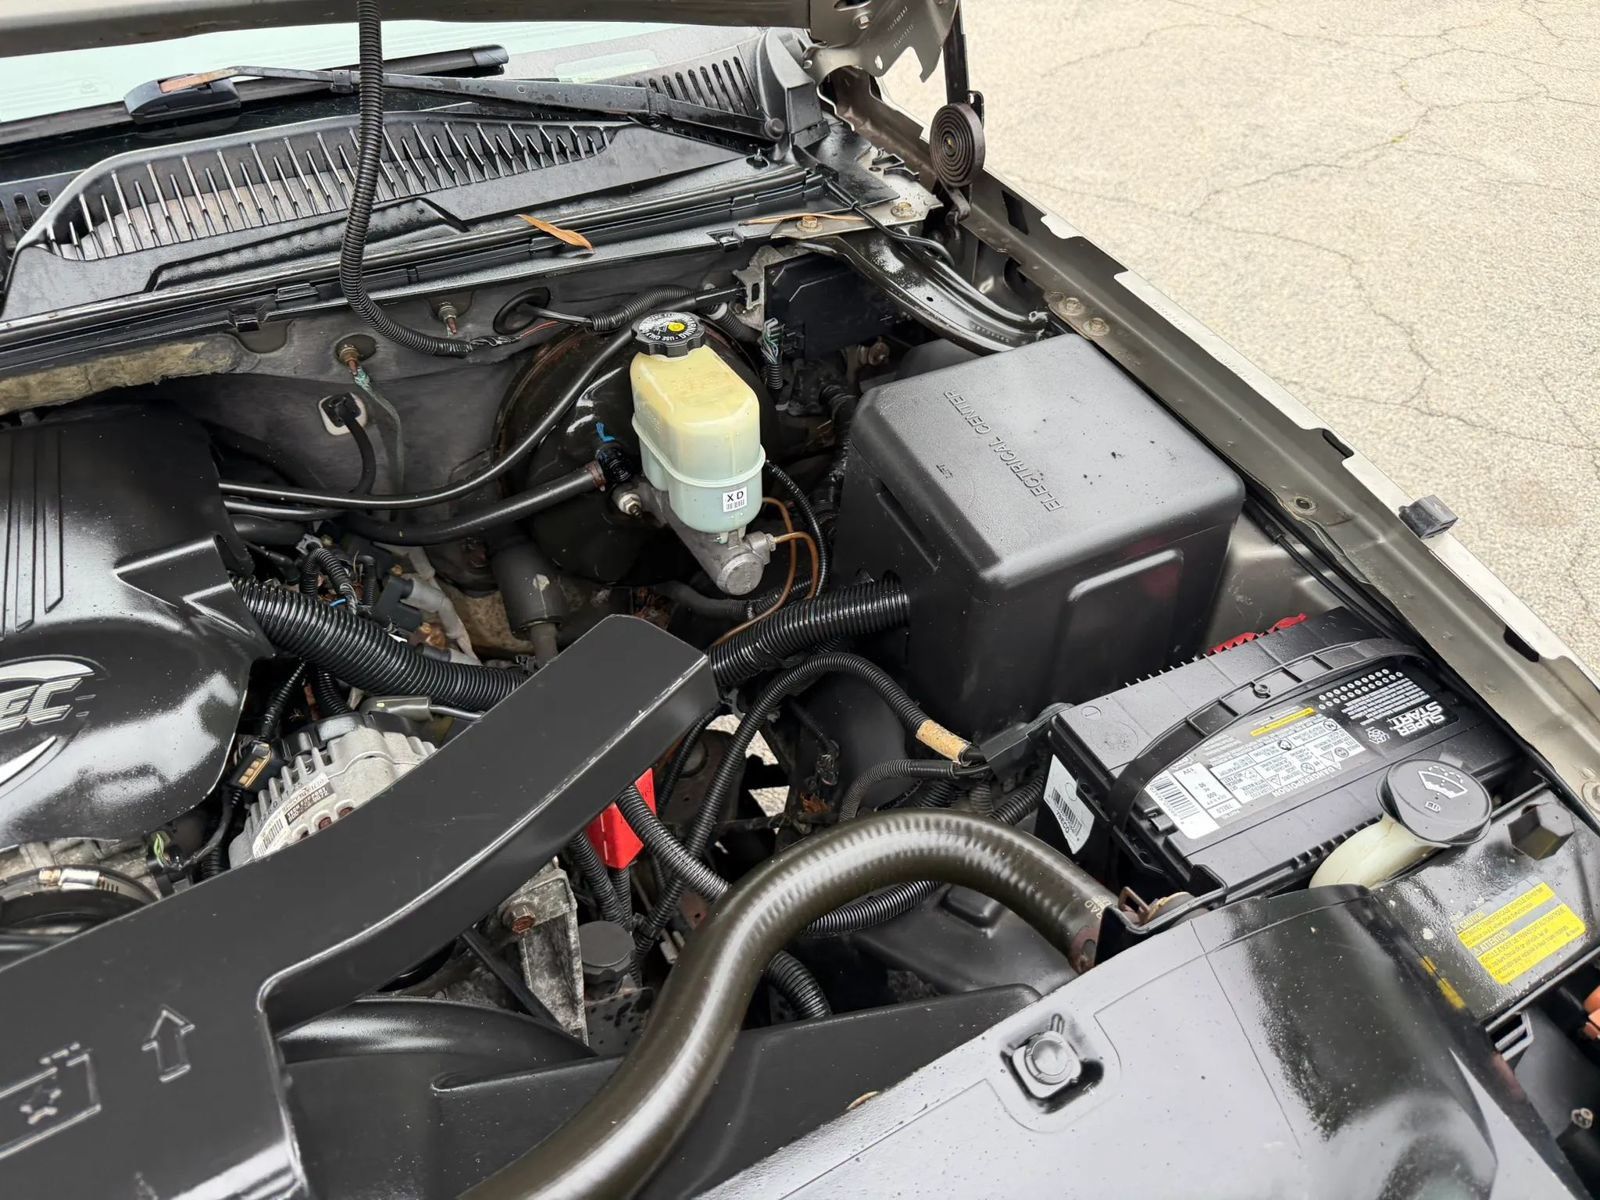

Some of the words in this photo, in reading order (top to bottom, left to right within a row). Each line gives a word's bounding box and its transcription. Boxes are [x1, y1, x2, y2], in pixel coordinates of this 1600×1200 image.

[943, 391, 991, 434] CENTER
[988, 436, 1064, 512] ELECTRICAL
[1386, 701, 1443, 730] START
[1397, 713, 1446, 737] SUPER
